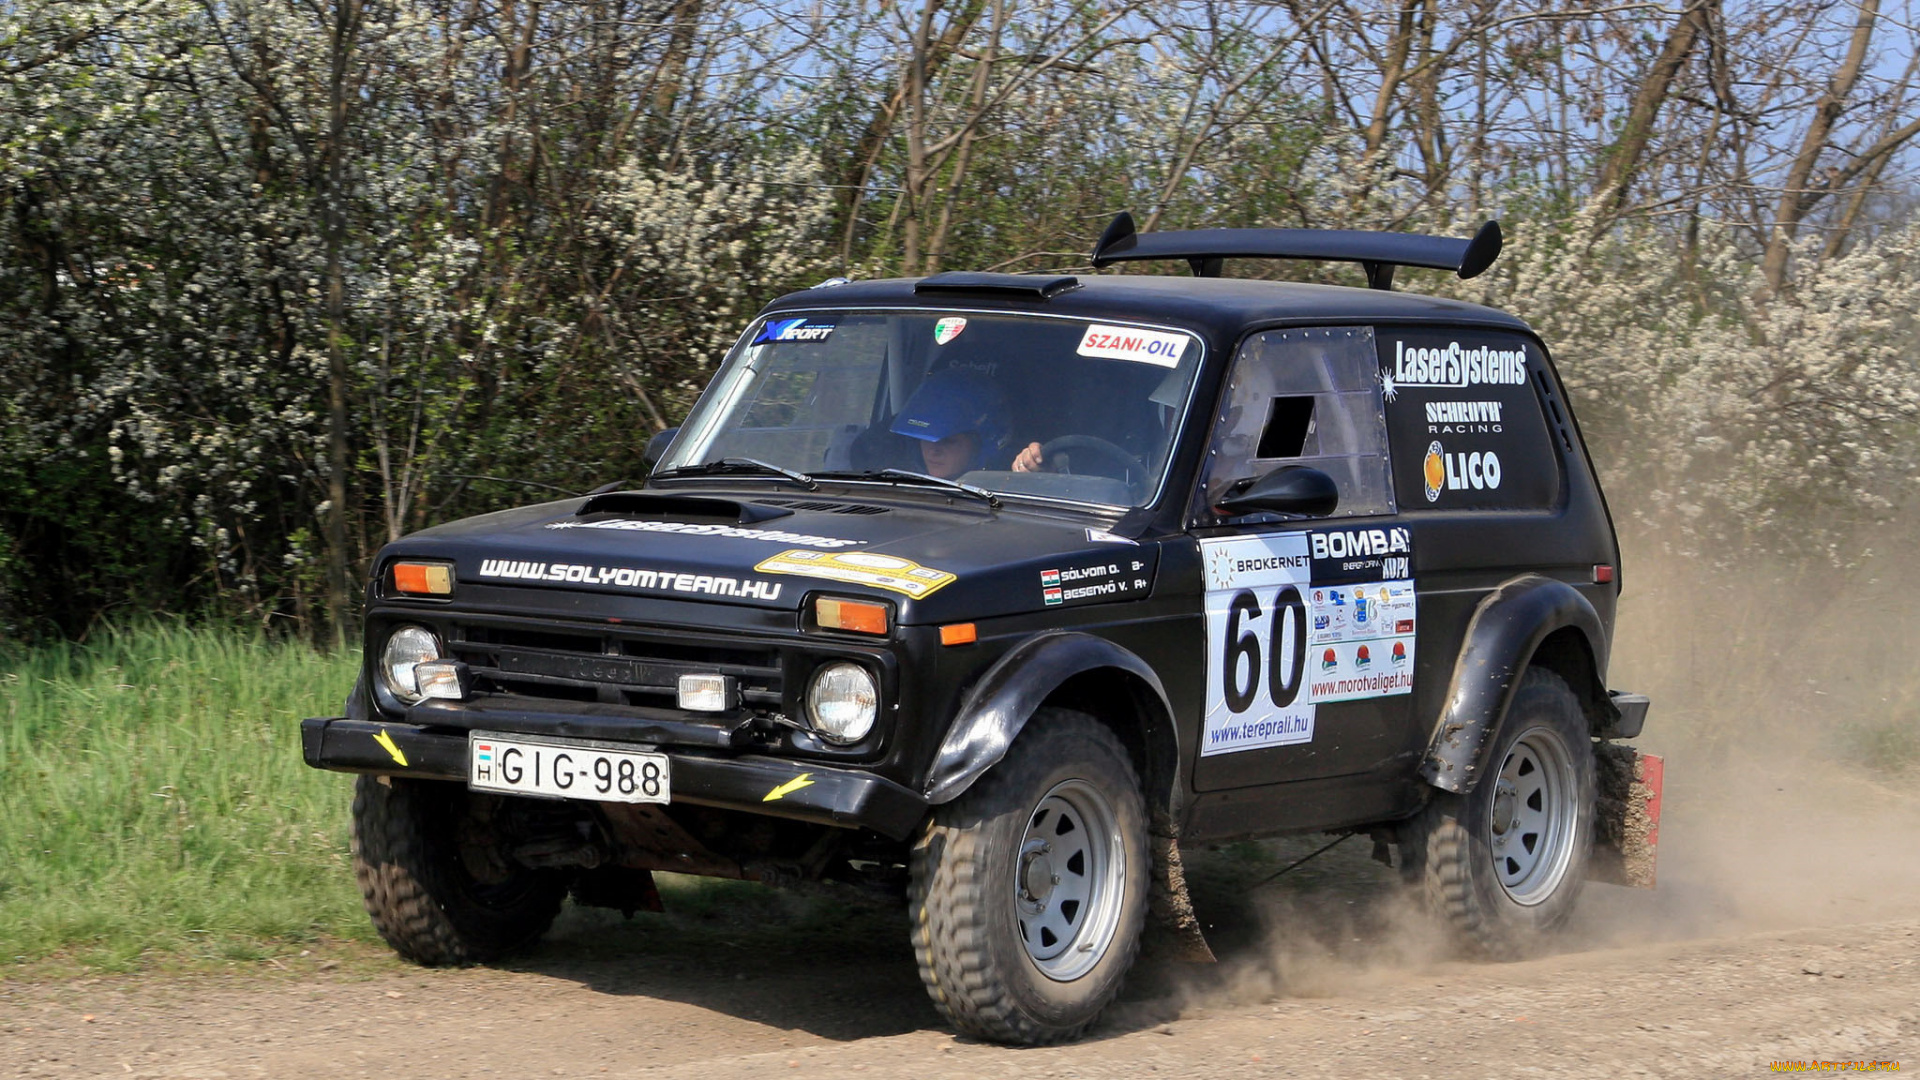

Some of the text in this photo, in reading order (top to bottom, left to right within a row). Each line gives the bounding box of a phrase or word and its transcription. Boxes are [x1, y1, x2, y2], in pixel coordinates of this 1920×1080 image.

[1085, 333, 1177, 358] SZANI-OIL
[1395, 340, 1527, 388] LaserSystems
[1425, 402, 1501, 423] SCHROTH
[1428, 425, 1503, 434] RACING
[1445, 451, 1501, 490] LICO
[1061, 566, 1107, 582] SÓLYOM
[1236, 554, 1310, 572] BROKERNET
[479, 558, 782, 600] WWW.SOLYOMTEAM.HU
[1117, 581, 1128, 592] V.
[1223, 584, 1307, 714] 60
[1311, 671, 1414, 697] www.morotvaliget.hu
[1211, 715, 1309, 744] www.tereprali.hu
[478, 764, 491, 782] H
[502, 747, 660, 797] GIG-988
